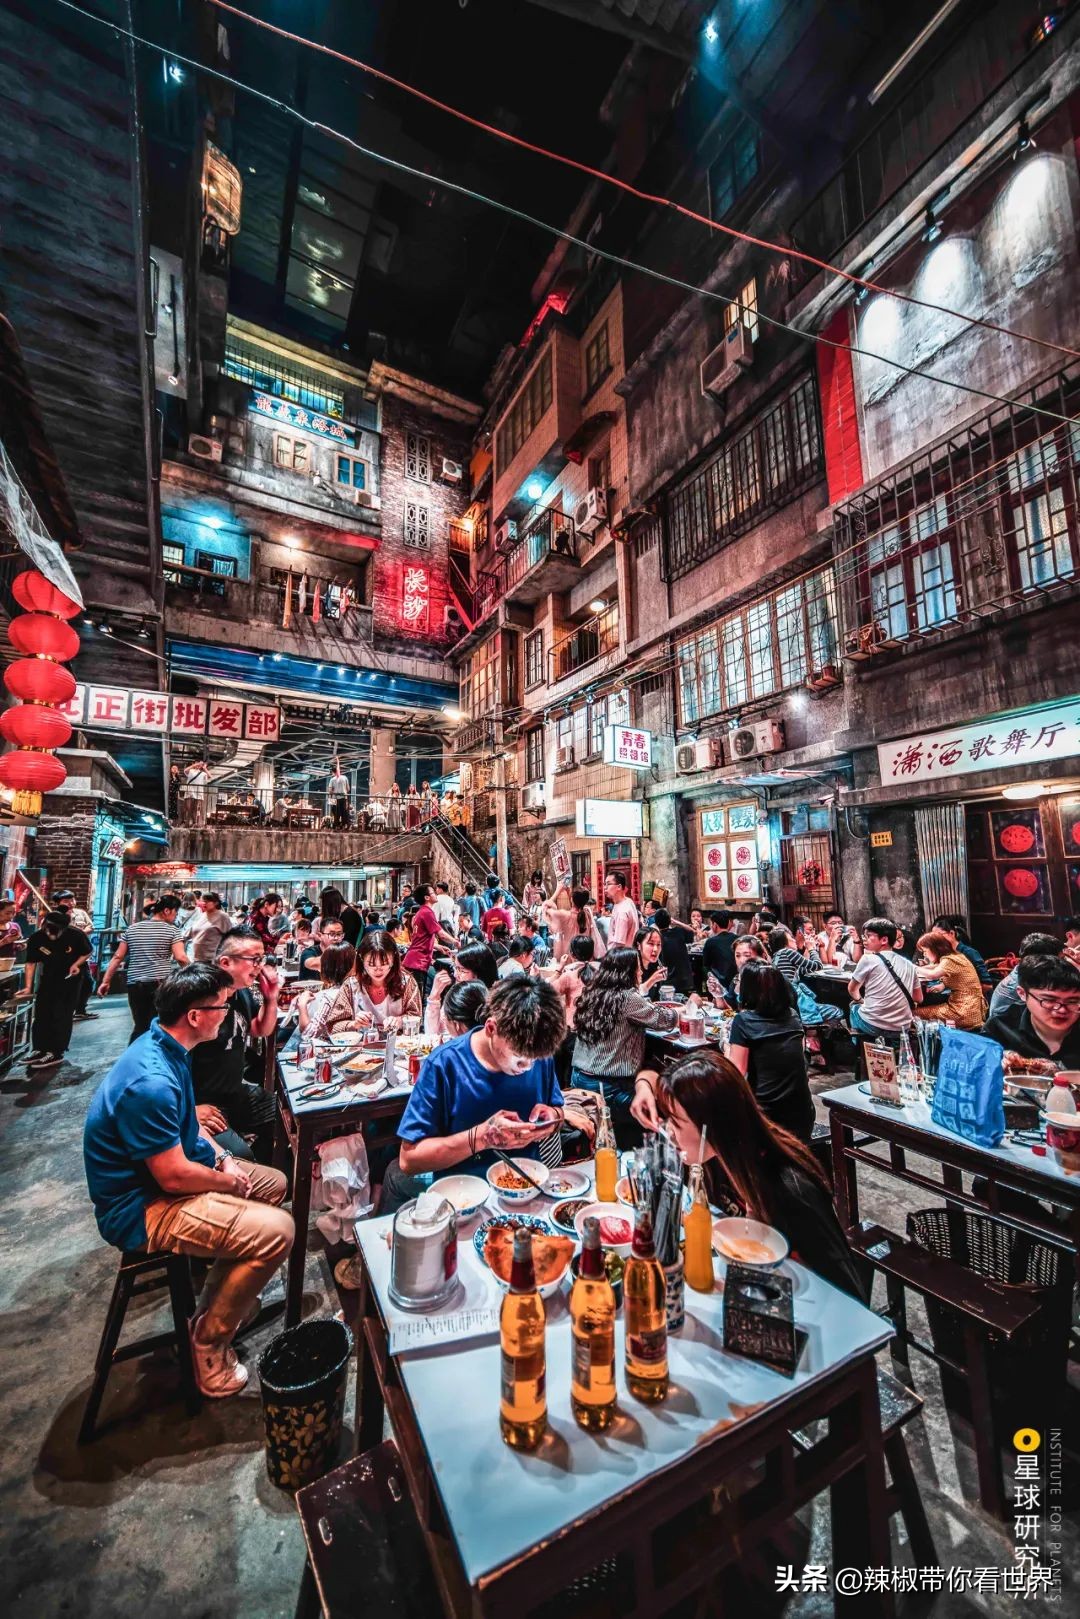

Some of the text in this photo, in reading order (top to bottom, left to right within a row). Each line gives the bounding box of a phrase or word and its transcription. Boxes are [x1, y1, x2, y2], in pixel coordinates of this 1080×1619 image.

[403, 567, 429, 620] 长沙
[621, 730, 647, 749] 青春
[893, 717, 1080, 777] 潇洒歌舞厅
